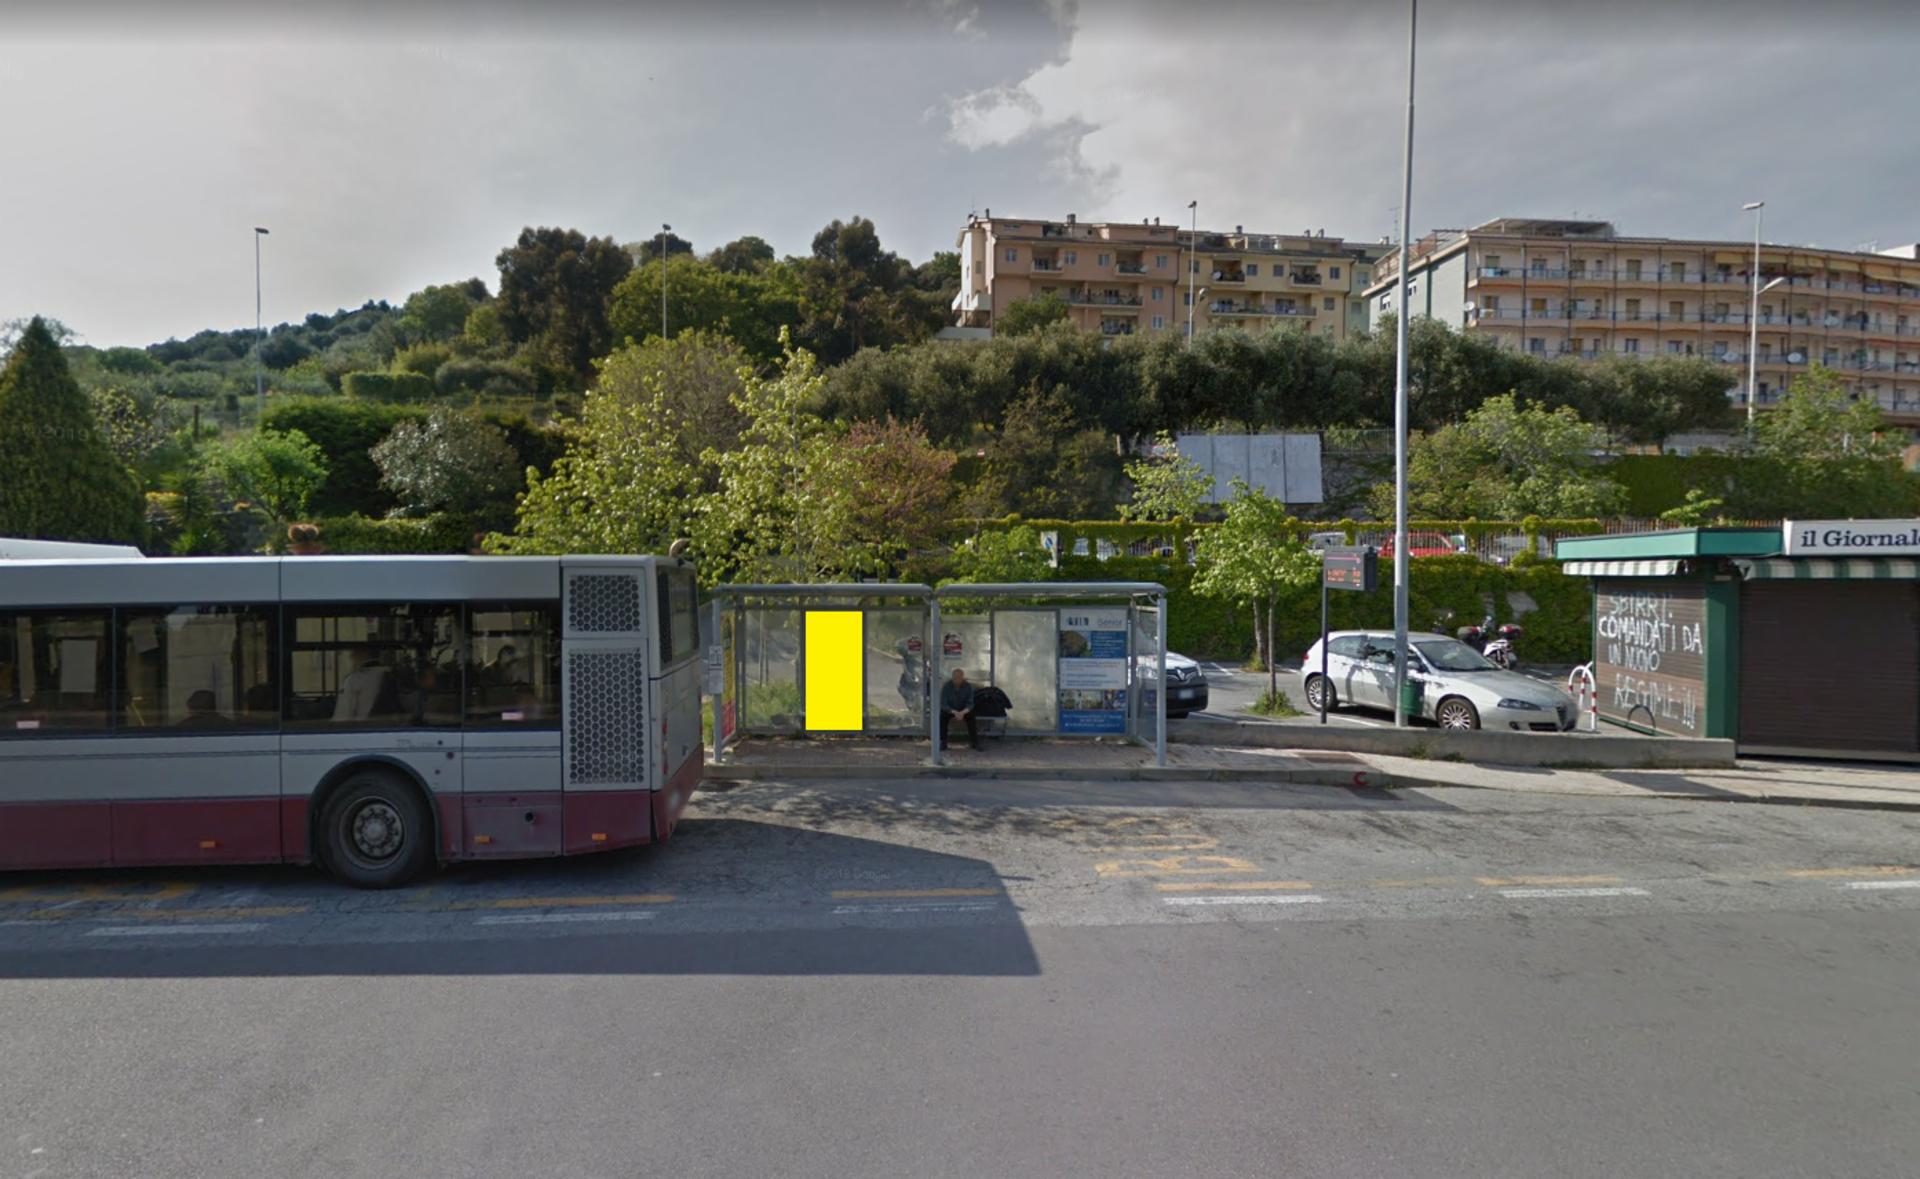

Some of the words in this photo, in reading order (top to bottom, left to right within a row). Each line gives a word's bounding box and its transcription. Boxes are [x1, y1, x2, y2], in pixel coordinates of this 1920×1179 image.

[1801, 530, 1817, 547] il
[1682, 622, 1703, 654] DA
[1608, 642, 1622, 665] UN
